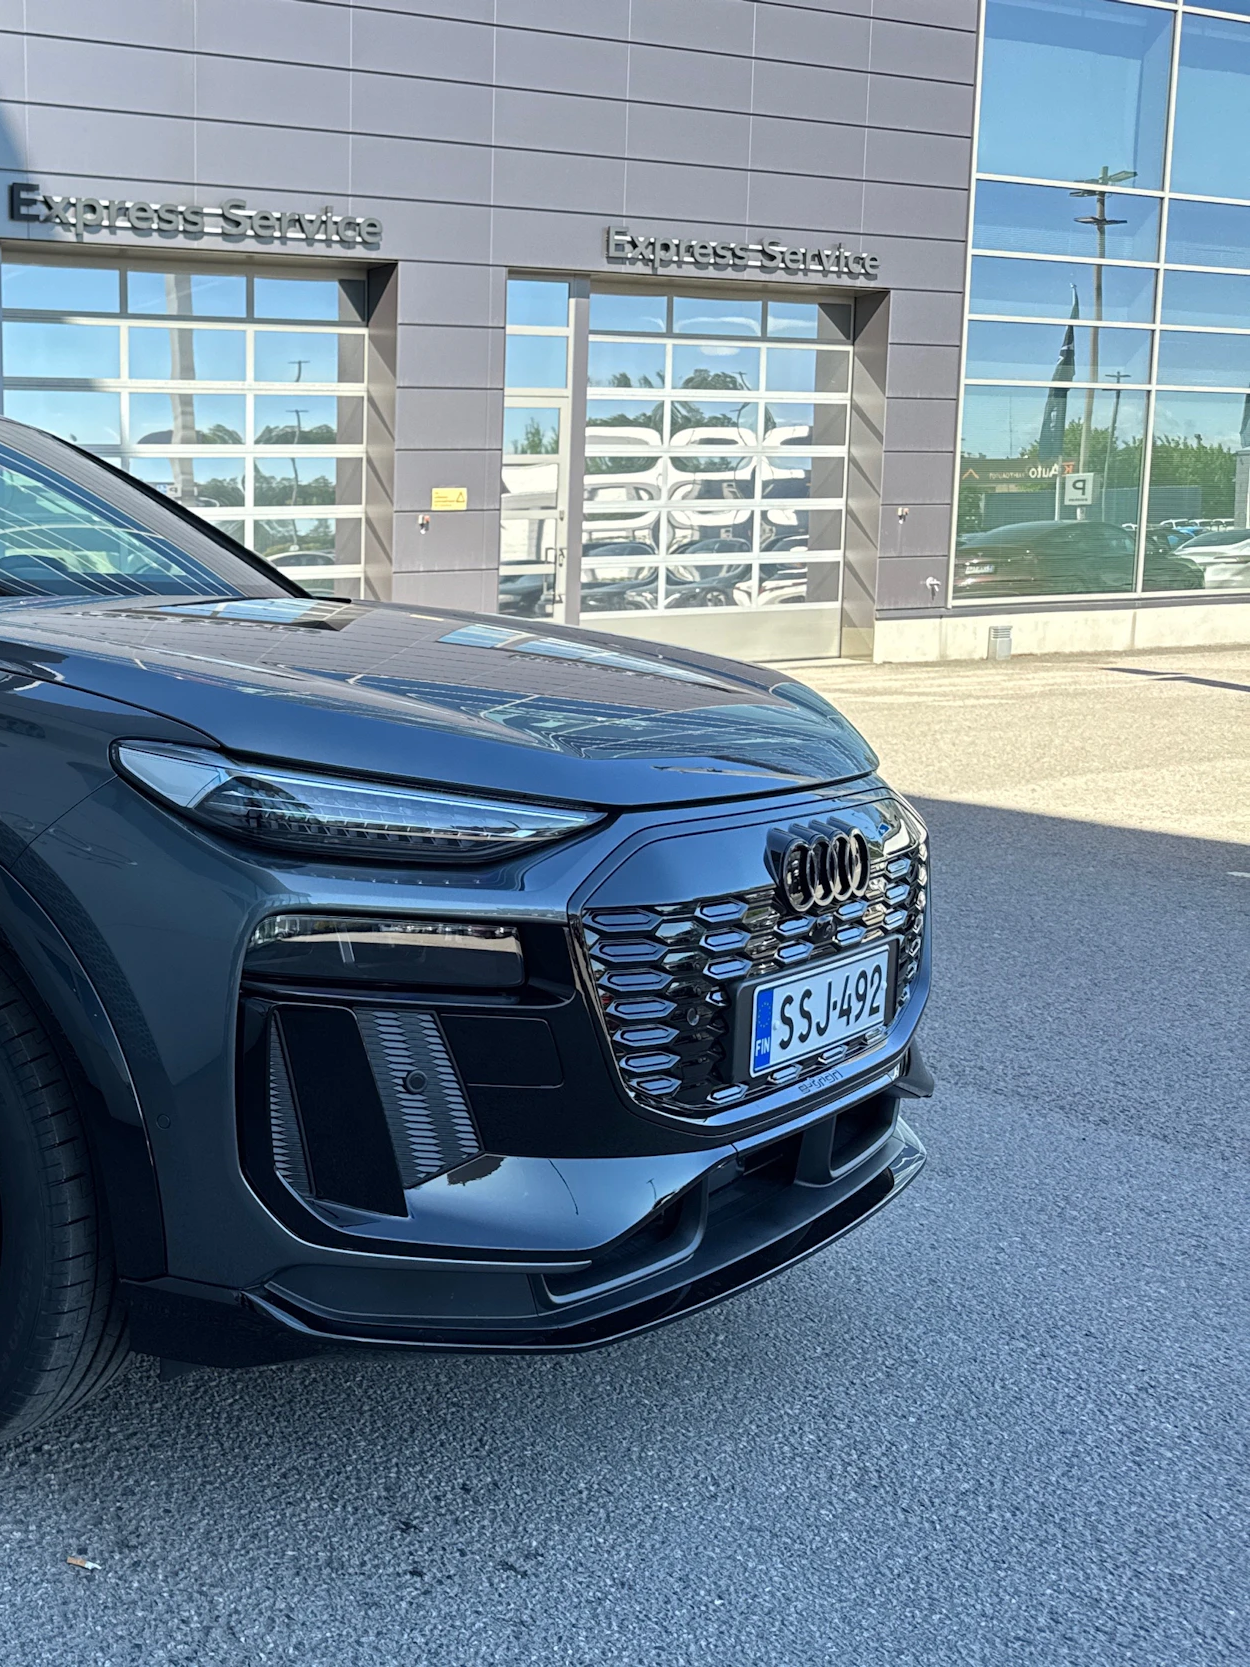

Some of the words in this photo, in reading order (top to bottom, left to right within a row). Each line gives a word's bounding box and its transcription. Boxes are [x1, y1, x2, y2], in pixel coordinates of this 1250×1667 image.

[9, 181, 206, 236] Express
[220, 197, 384, 246] Service
[607, 225, 751, 270] Express
[760, 235, 882, 277] Service
[778, 963, 883, 1050] SSJ-492
[754, 1036, 771, 1057] FIN
